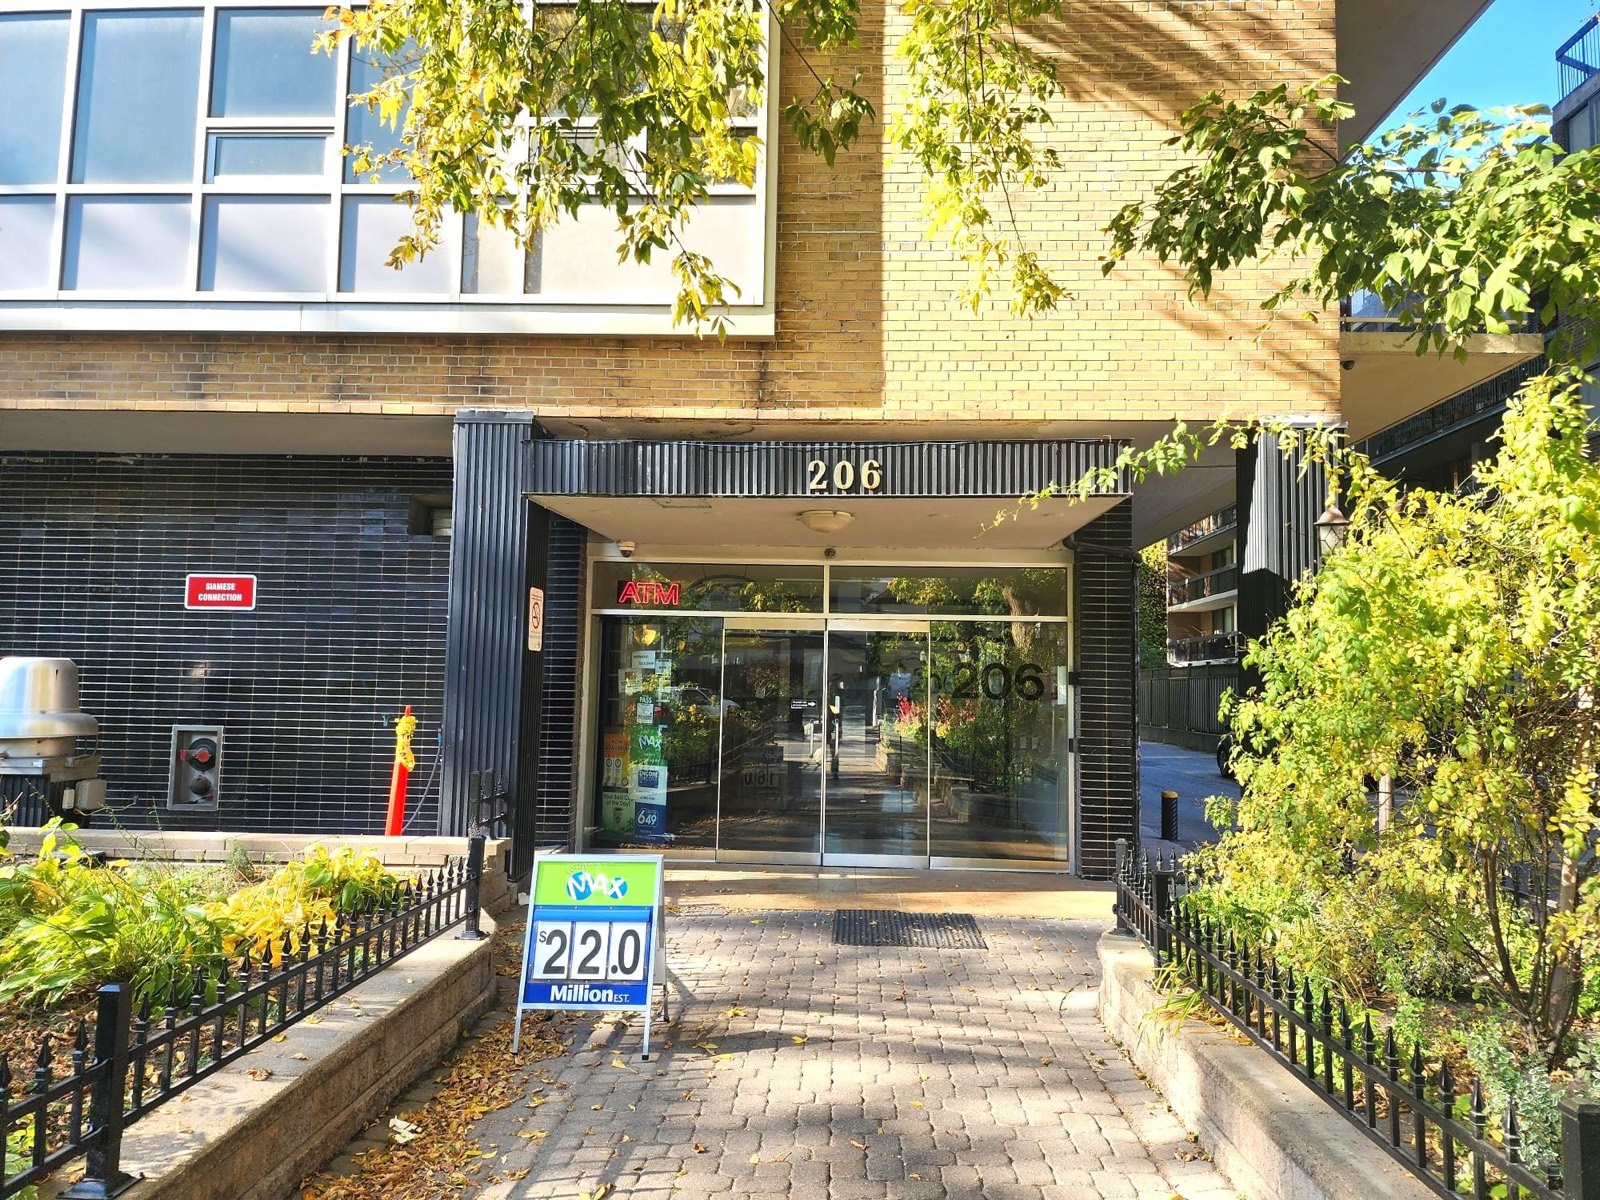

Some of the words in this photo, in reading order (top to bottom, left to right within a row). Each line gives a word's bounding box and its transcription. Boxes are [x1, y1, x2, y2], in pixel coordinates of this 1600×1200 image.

[807, 459, 881, 490] 206
[618, 581, 680, 606] ATM
[952, 662, 1045, 701] 206
[567, 871, 627, 901] MAX
[550, 984, 614, 1003] Million
[614, 993, 630, 1003] EST.
